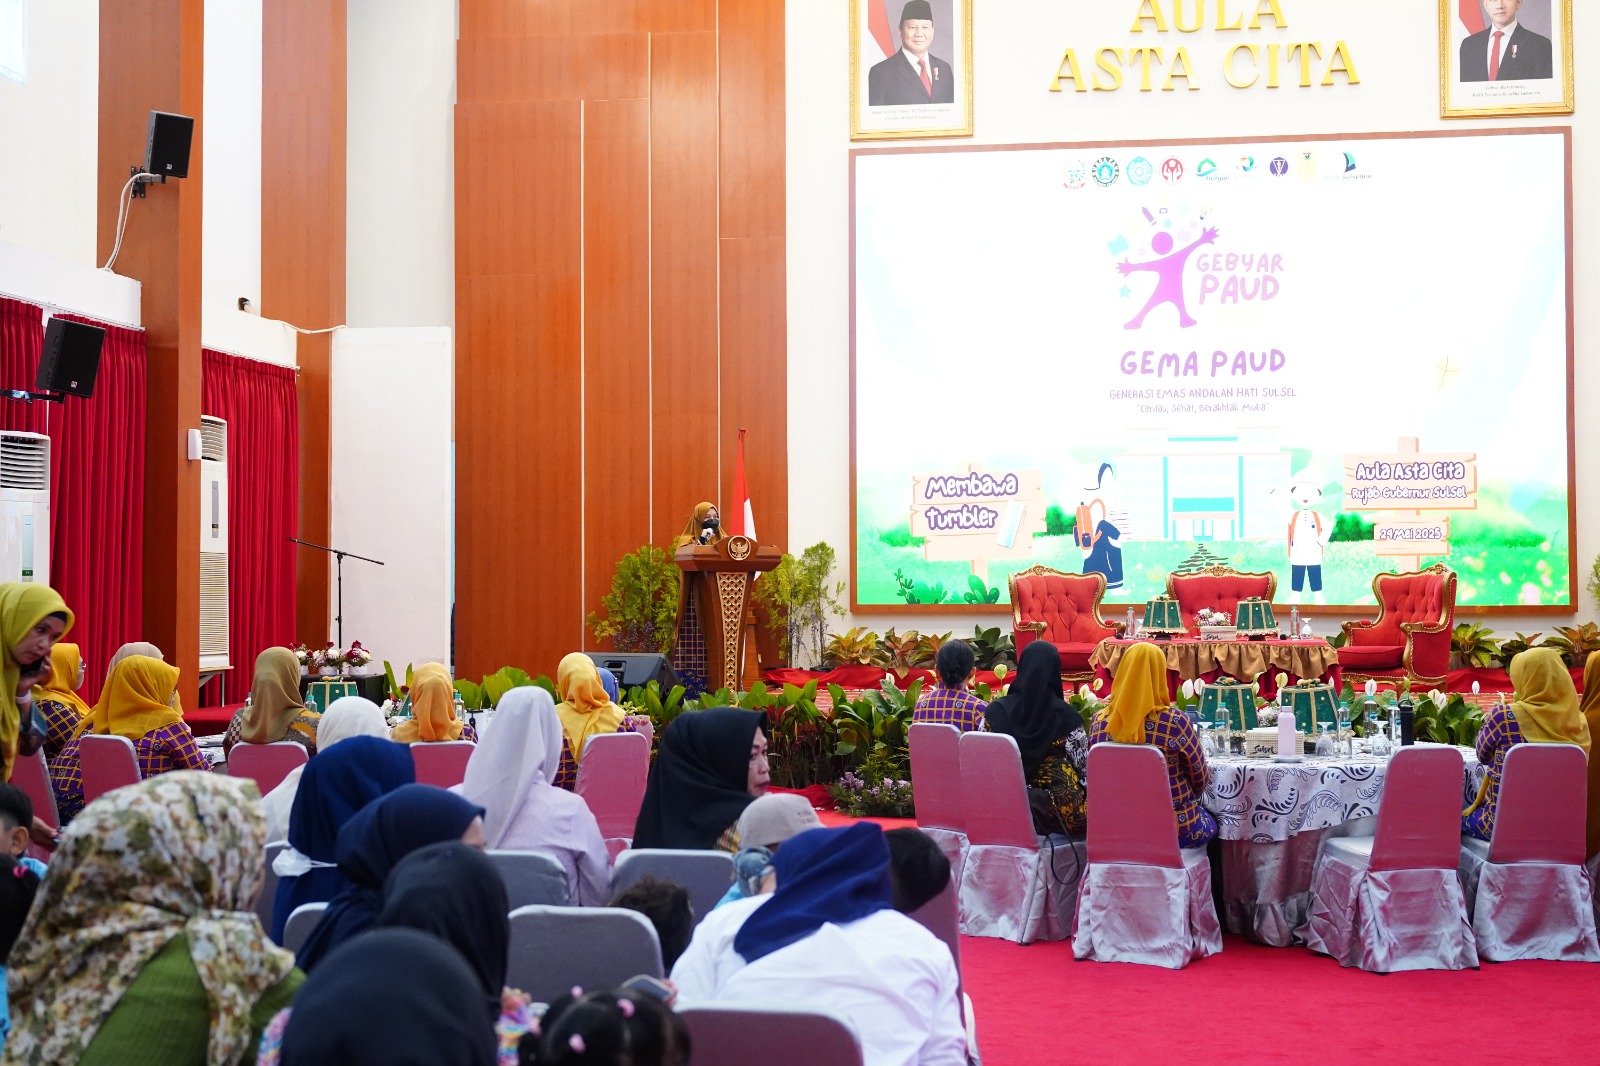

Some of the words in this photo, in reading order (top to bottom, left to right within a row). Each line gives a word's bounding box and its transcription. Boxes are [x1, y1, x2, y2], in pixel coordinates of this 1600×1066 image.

[1130, 0, 1288, 33] AULA
[1049, 46, 1200, 92] ASTA
[1223, 40, 1360, 89] CITA
[1196, 252, 1284, 273] GEBYAR
[1199, 273, 1280, 305] PAUD
[1120, 350, 1198, 378] GEMA
[1211, 348, 1286, 377] PAUD
[1110, 389, 1154, 399] GENERASI
[1156, 388, 1186, 399] EMAS
[1189, 387, 1233, 398] ANDALAN
[1236, 387, 1258, 397] HATI
[1262, 387, 1297, 397] SULSEL
[1356, 461, 1391, 480] Aula
[1394, 461, 1430, 480] Asta
[1432, 461, 1466, 480] Cita
[925, 472, 1018, 499] Membawa
[1351, 486, 1380, 505] Rujab
[1382, 486, 1431, 499] Gubernur
[1415, 527, 1442, 540] 2025
